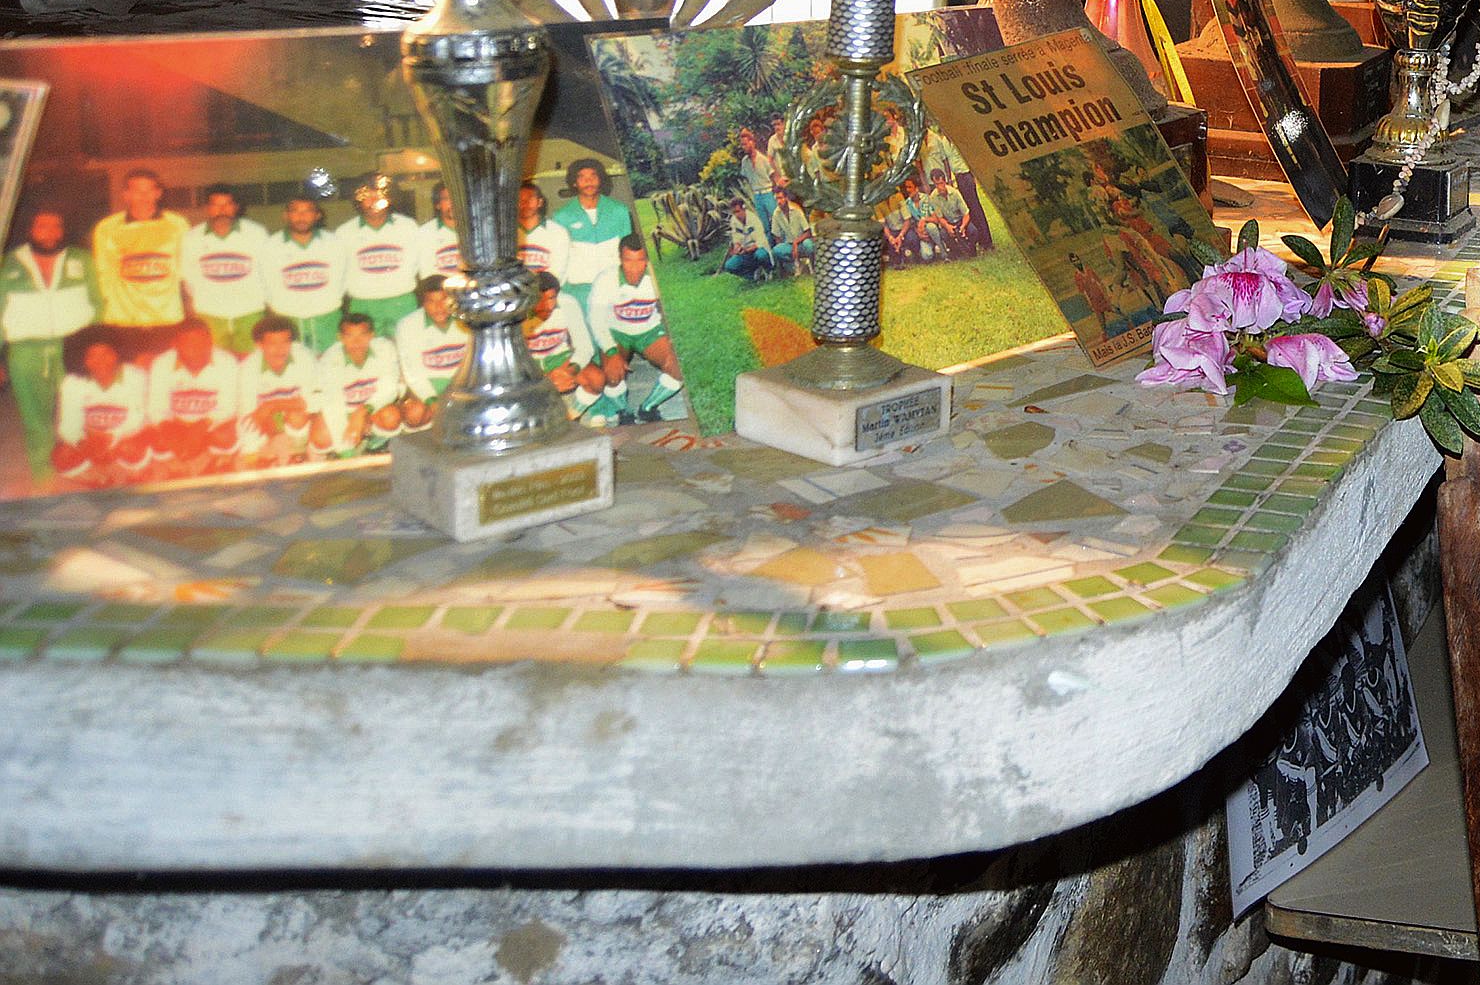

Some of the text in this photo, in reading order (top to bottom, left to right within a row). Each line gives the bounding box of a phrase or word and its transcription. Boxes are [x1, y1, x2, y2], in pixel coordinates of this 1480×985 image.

[912, 65, 963, 87] Football
[960, 62, 1086, 115] St Louis
[984, 96, 1123, 157] champion
[1092, 345, 1114, 360] Mais
[1113, 341, 1123, 351] la
